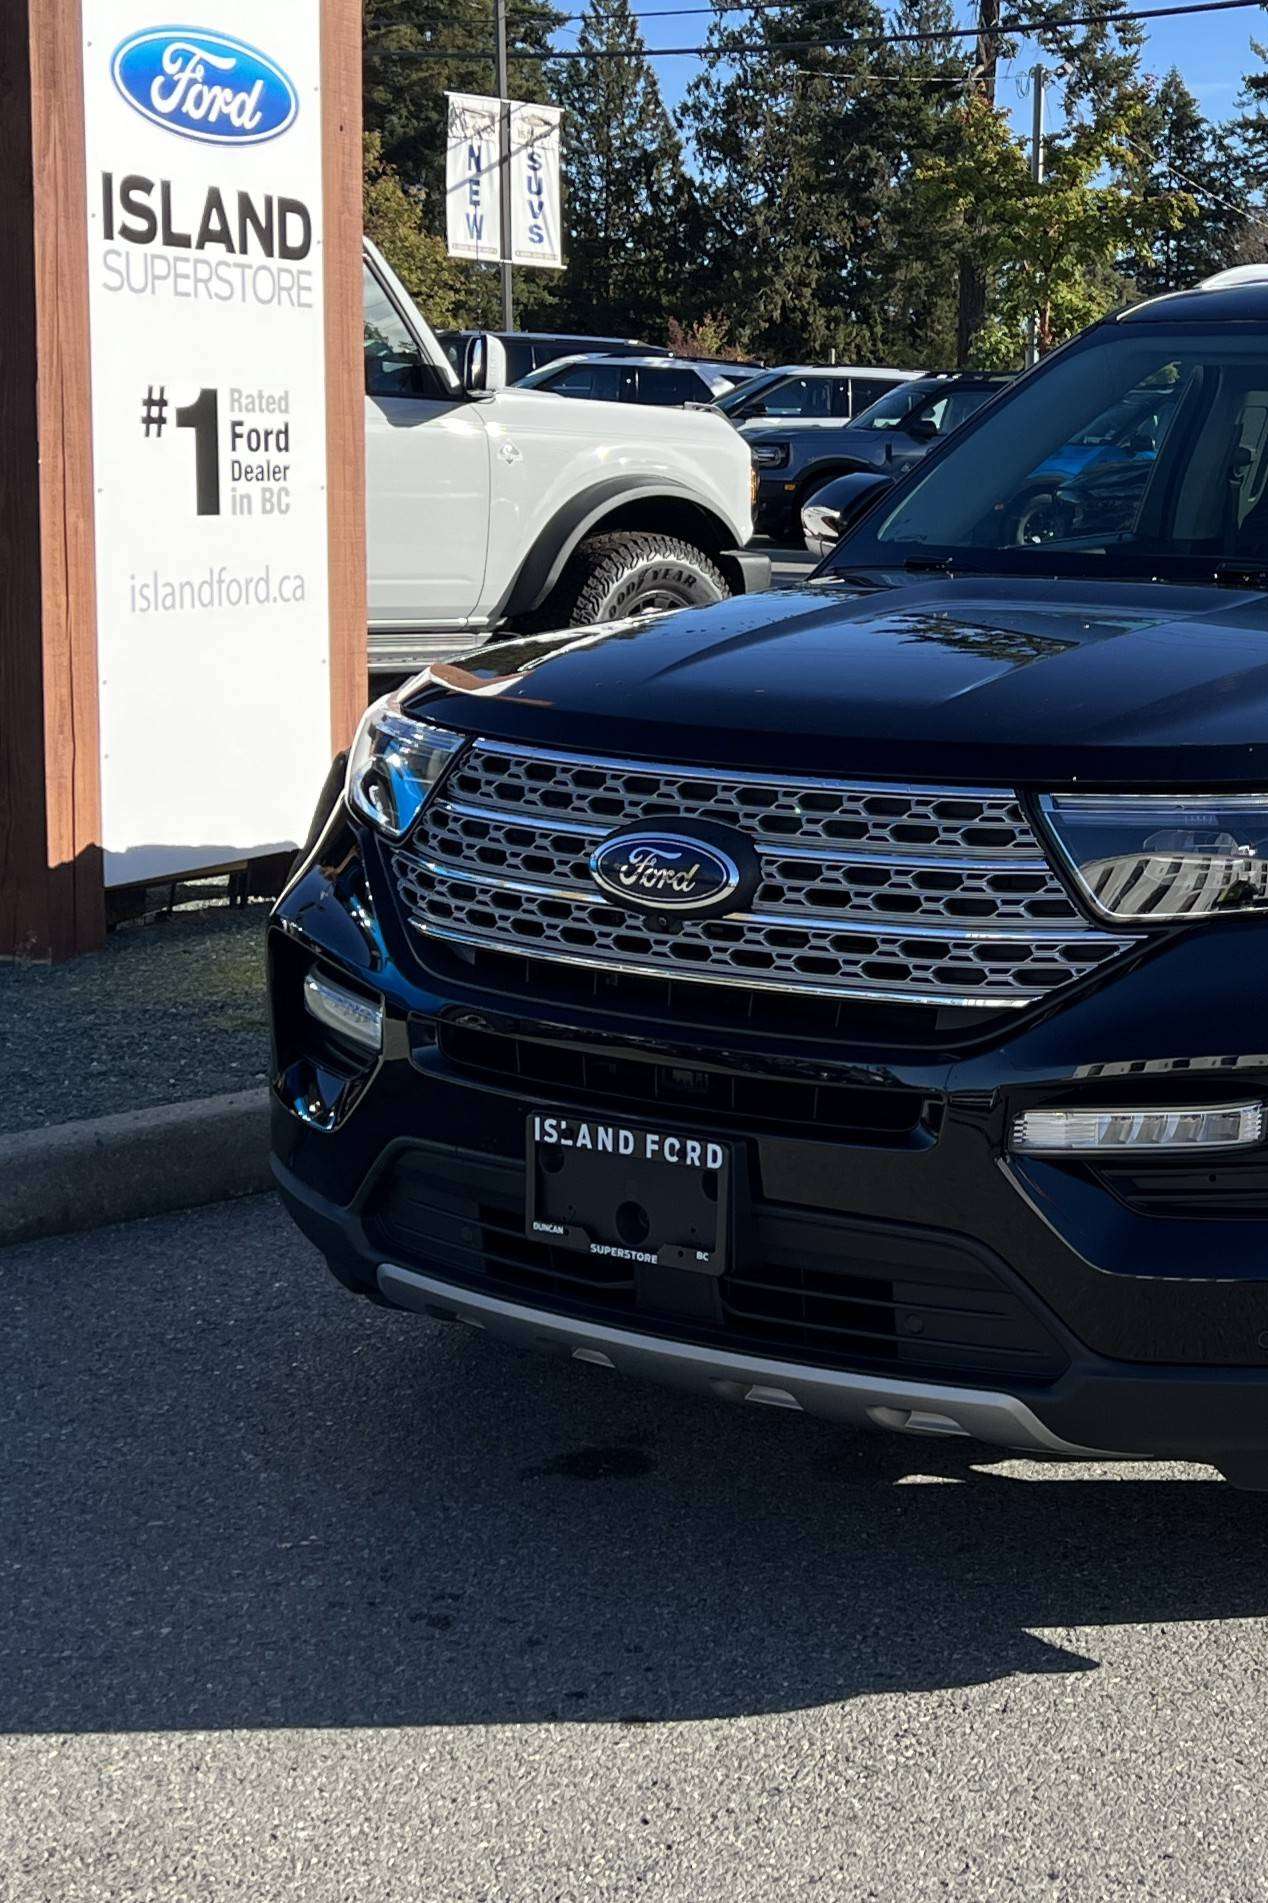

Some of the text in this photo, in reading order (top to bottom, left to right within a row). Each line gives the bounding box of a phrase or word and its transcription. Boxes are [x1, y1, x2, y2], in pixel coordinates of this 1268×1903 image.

[150, 42, 264, 130] Ford
[101, 170, 312, 261] ISLAND
[465, 144, 484, 241] NEW
[526, 151, 545, 245] SUVS
[102, 249, 313, 308] SUPERSTORE
[229, 387, 290, 414] Rated
[141, 385, 220, 516] #1
[230, 420, 290, 452] Ford
[231, 459, 290, 482] Dealer
[231, 486, 291, 516] in BC
[130, 565, 305, 613] islandford.ca
[619, 846, 700, 893] Ford
[533, 1116, 724, 1169] ISLAND FORD
[533, 1221, 564, 1235] DUNCAN
[590, 1243, 658, 1265] SUPERSTORE
[696, 1251, 709, 1262] BC
